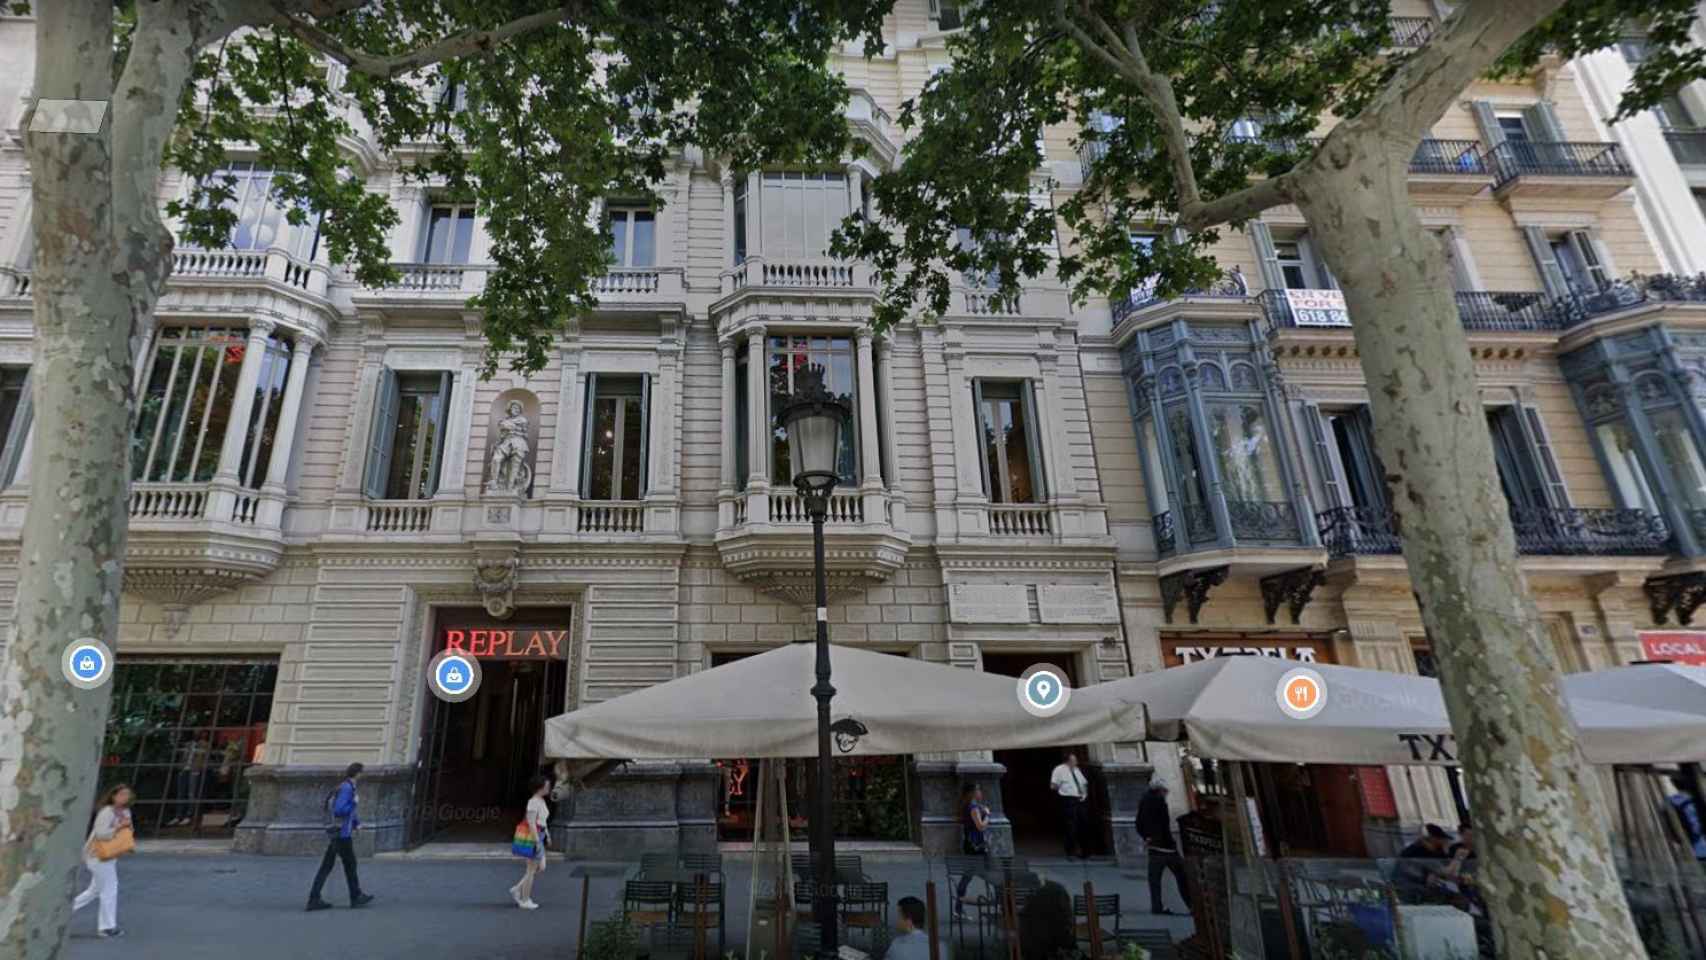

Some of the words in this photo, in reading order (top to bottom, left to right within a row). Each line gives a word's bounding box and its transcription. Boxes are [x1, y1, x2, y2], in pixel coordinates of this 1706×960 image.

[1298, 310, 1327, 322] 618
[444, 630, 569, 656] REPLAY
[1650, 642, 1706, 656] LOCAL
[1397, 733, 1456, 760] TX
